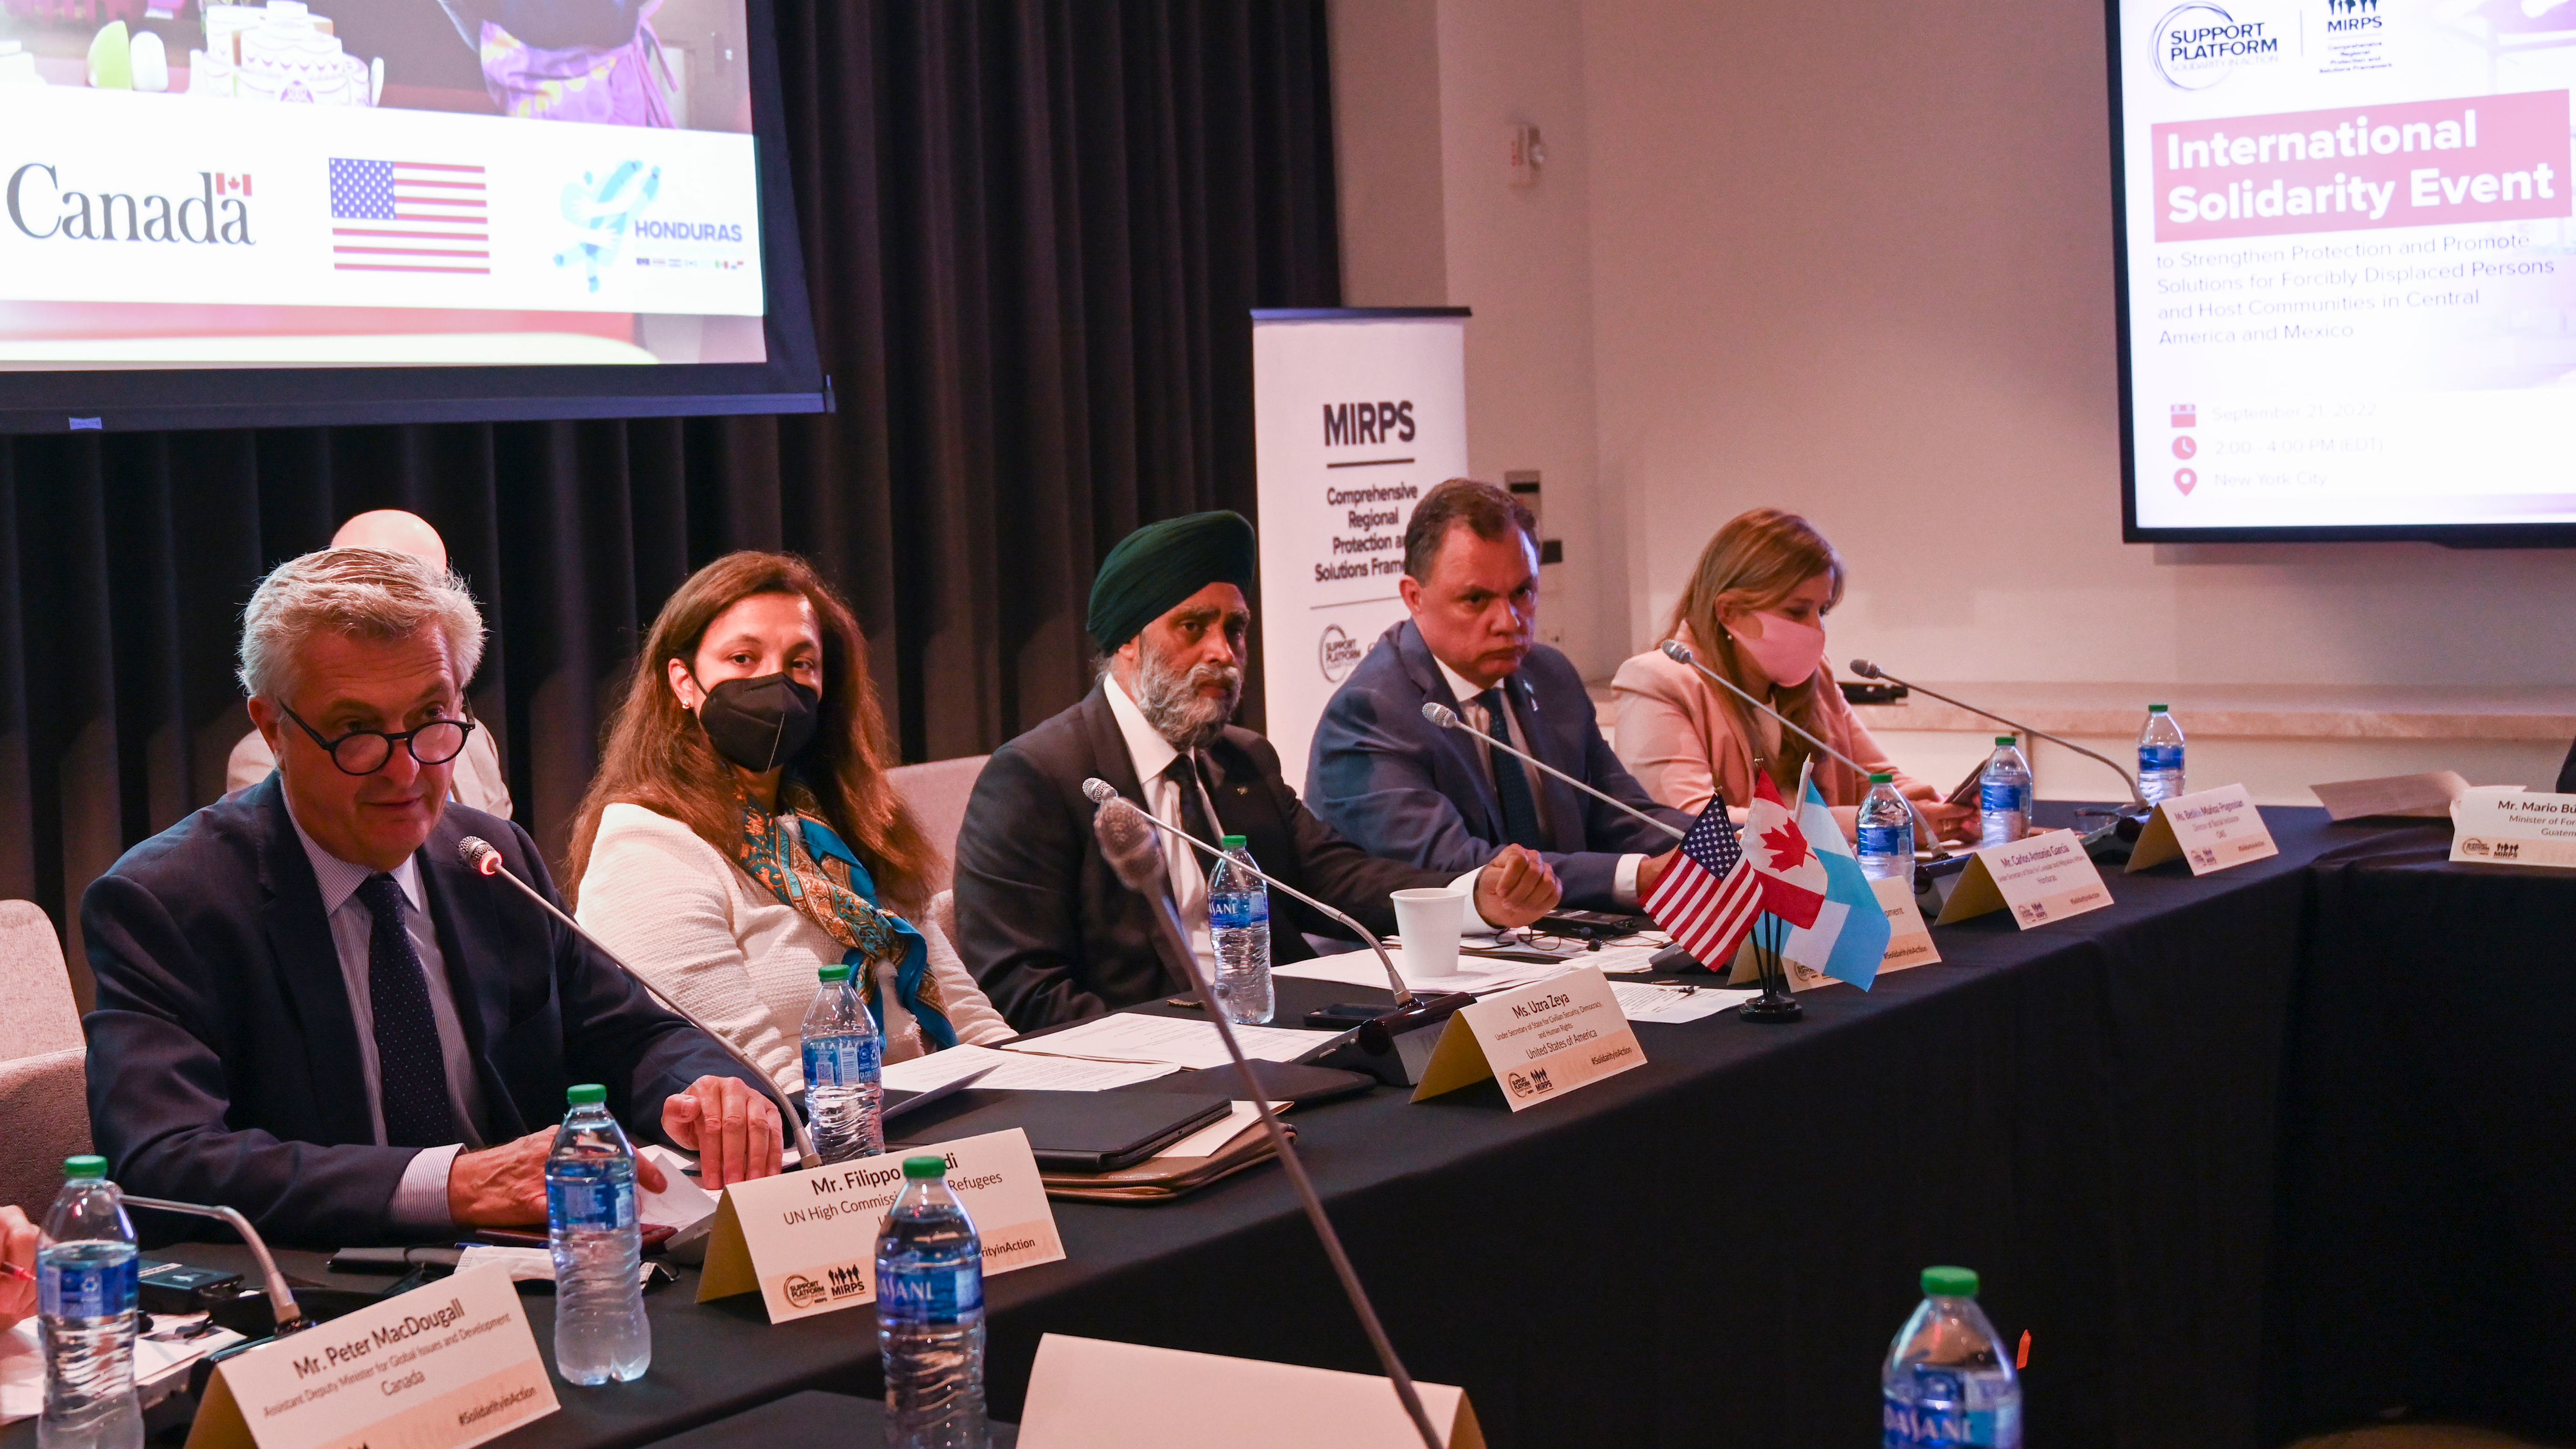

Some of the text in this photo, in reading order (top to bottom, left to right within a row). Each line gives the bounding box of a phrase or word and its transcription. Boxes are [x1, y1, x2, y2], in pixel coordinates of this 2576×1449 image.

[2171, 23, 2265, 45] SUPPORT
[2328, 16, 2382, 32] MIRPS
[2171, 38, 2277, 61] PLATFORM
[2167, 109, 2477, 170] International
[7, 163, 256, 245] Canada
[2168, 163, 2555, 223] Solidarity Event
[635, 220, 742, 242] HONDURAS
[2157, 235, 2530, 269] to Strengthen Protection and Promote
[2158, 259, 2555, 294] Solutions for Forcibly Displaced Persons
[2158, 290, 2479, 319] and Host Communities in Central
[2159, 323, 2353, 345] America and Mexico
[1323, 400, 1415, 447] MIRPS
[2212, 406, 2301, 424] September
[2333, 403, 2377, 417] 2022
[2309, 439, 2335, 452] PM
[2340, 437, 2384, 453] (EDT)
[2214, 471, 2328, 487] New York City
[1327, 482, 1418, 507] Comprehensive
[1349, 507, 1399, 532] Regional
[1333, 533, 1392, 555] Protection
[1315, 561, 1368, 582] Solutions
[2498, 800, 2517, 810] Mr.
[2522, 802, 2557, 812] Mario
[2509, 815, 2546, 825] Minister
[2541, 828, 2576, 837] Guatem
[2001, 858, 2013, 867] Mr.
[2011, 854, 2030, 865] Carlos
[2029, 848, 2052, 861] Antonio
[1512, 994, 1569, 1019] Ms. Uzra Zeya
[1508, 1027, 1527, 1036] Secretary
[1549, 1014, 1564, 1022] Civilian
[1563, 1009, 1581, 1018] Security,
[1579, 1002, 1603, 1013] Democracy,
[1545, 1028, 1561, 1036] Human
[1560, 1023, 1573, 1031] Rights
[1526, 1029, 1597, 1059] United States of America
[1591, 1047, 1632, 1065] #SolidarityinAction
[1535, 1080, 1552, 1091] MIRPS
[812, 1169, 900, 1195] Mr. Filippo
[784, 1174, 1002, 1225] UN High Commissi Refugees
[981, 1239, 1036, 1257] rityinAction
[790, 1281, 819, 1293] SUPPORT
[791, 1286, 825, 1297] PLATFORM
[831, 1281, 864, 1296] MIRPS
[293, 1298, 464, 1378] Mr. Peter MacDougall
[264, 1313, 511, 1417] Assistant Deputy Minister for Global Issues and Development
[381, 1370, 425, 1396] Canada
